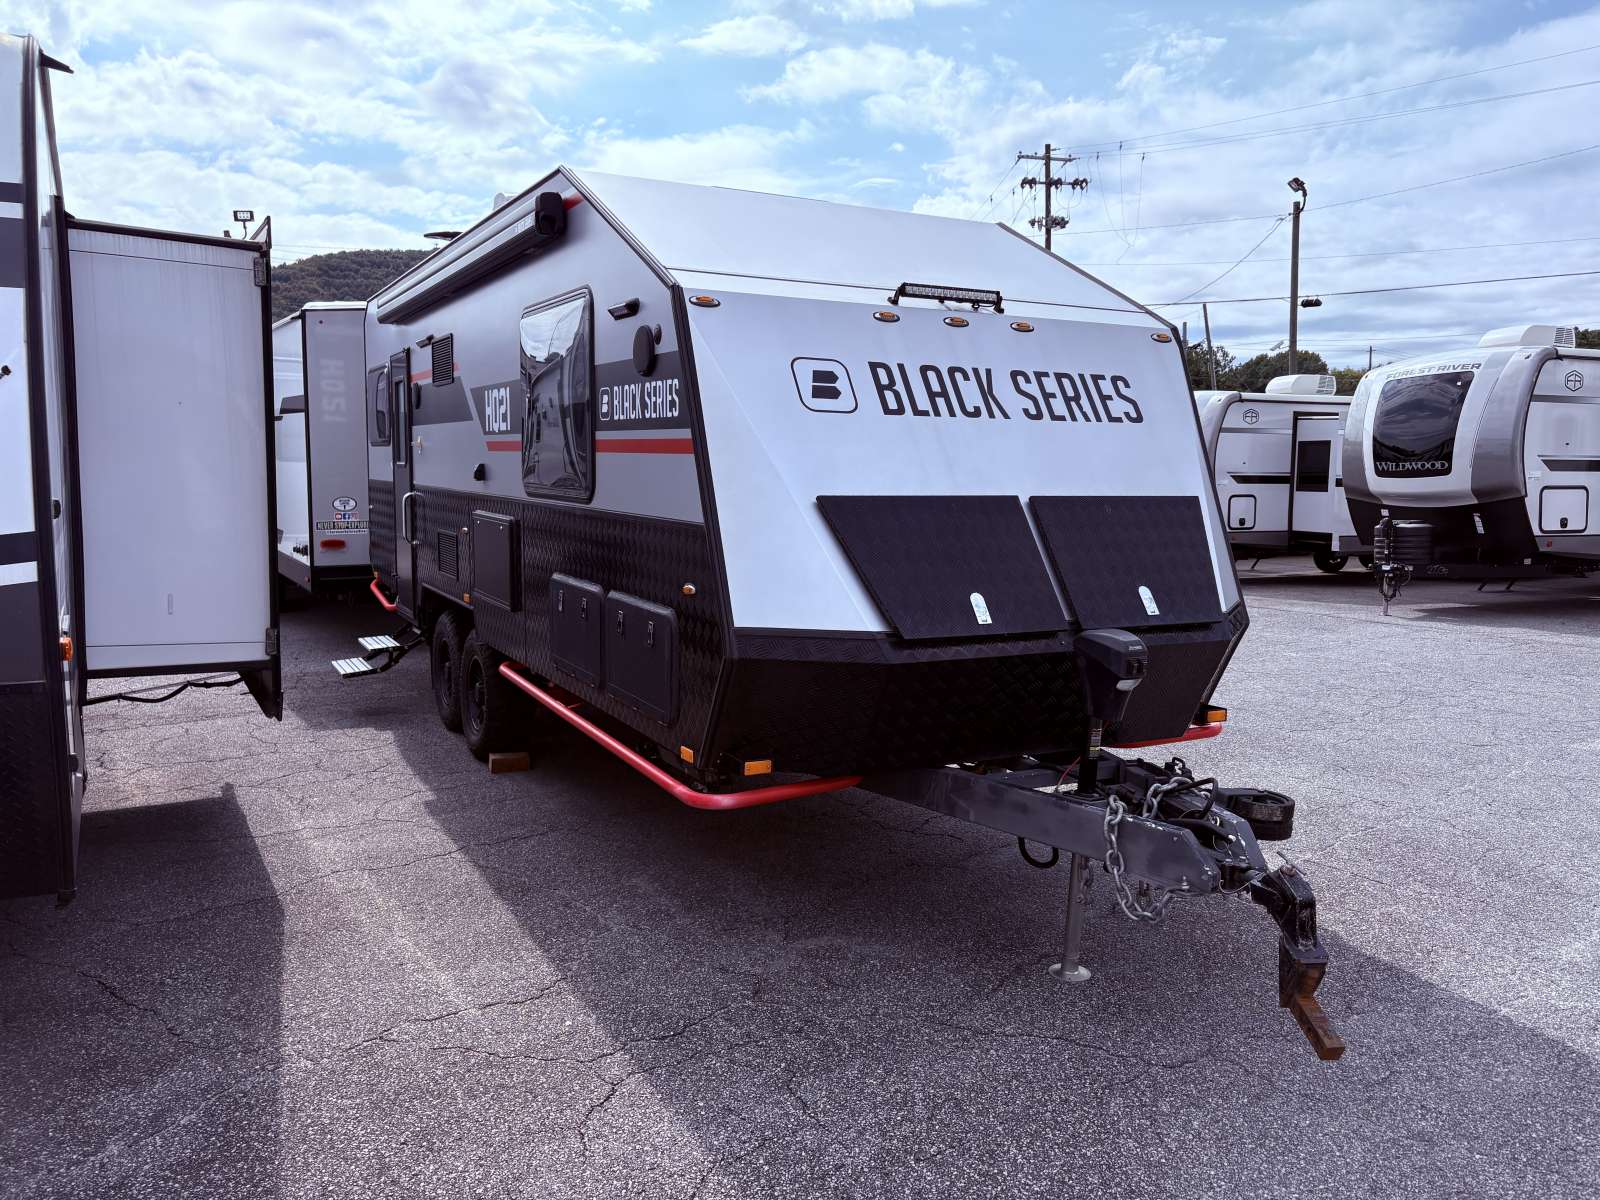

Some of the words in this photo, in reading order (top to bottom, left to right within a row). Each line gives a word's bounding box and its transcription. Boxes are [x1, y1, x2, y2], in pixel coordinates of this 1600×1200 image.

[1385, 366, 1437, 380] FOREST
[1438, 363, 1482, 373] RIVER
[613, 383, 643, 421] BLACK
[644, 378, 680, 419] SERIES
[868, 361, 1011, 420] BLACK
[1010, 369, 1144, 424] SERIES
[484, 386, 511, 433] HQ21
[1376, 460, 1449, 472] WILDWOOD
[318, 522, 333, 530] NEVER
